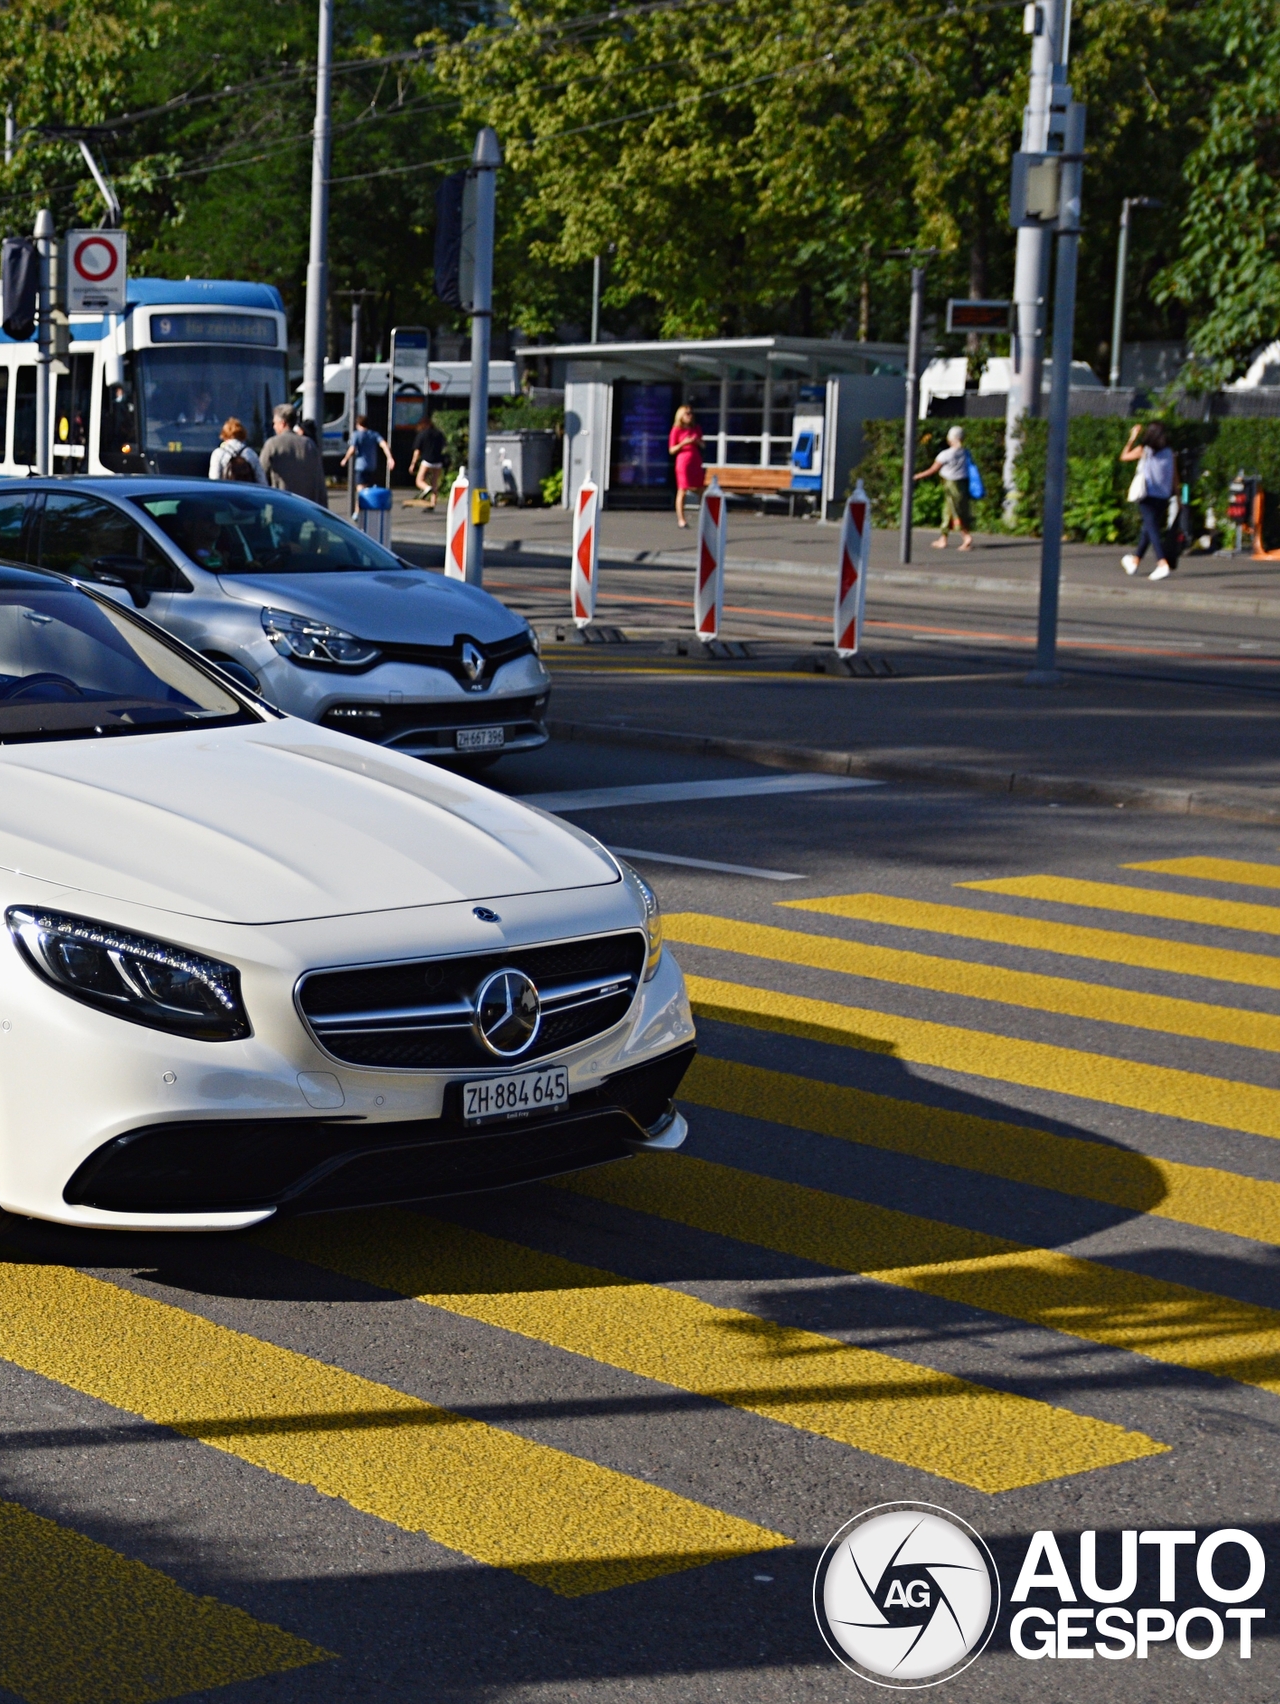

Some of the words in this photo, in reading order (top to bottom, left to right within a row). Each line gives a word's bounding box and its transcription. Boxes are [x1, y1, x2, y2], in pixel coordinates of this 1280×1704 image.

[160, 318, 172, 335] 9
[487, 729, 503, 743] 396
[533, 1073, 565, 1103] 645
